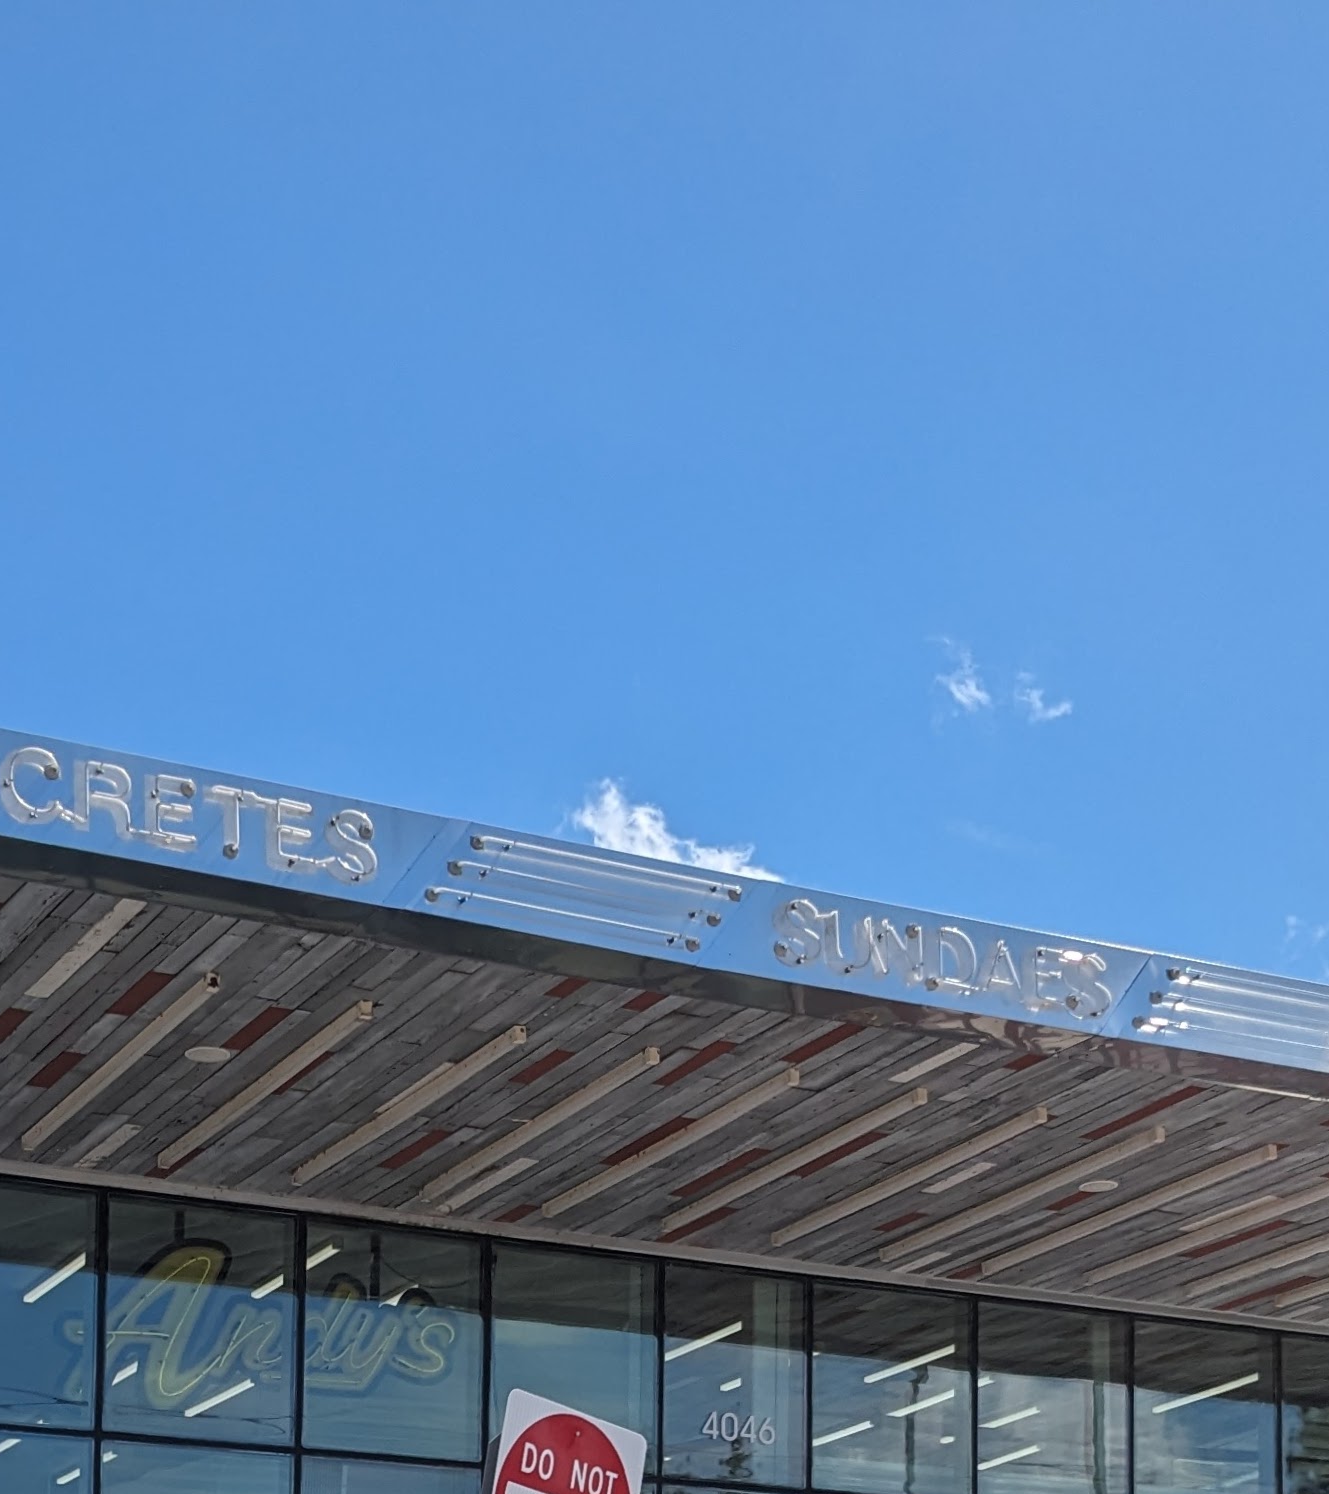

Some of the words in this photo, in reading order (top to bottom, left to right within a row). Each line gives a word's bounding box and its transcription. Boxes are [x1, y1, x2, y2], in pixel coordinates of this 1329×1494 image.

[772, 898, 1113, 1020] SUNDAES
[60, 1244, 459, 1407] Andy's
[521, 1442, 554, 1481] DO
[701, 1411, 776, 1445] 4046
